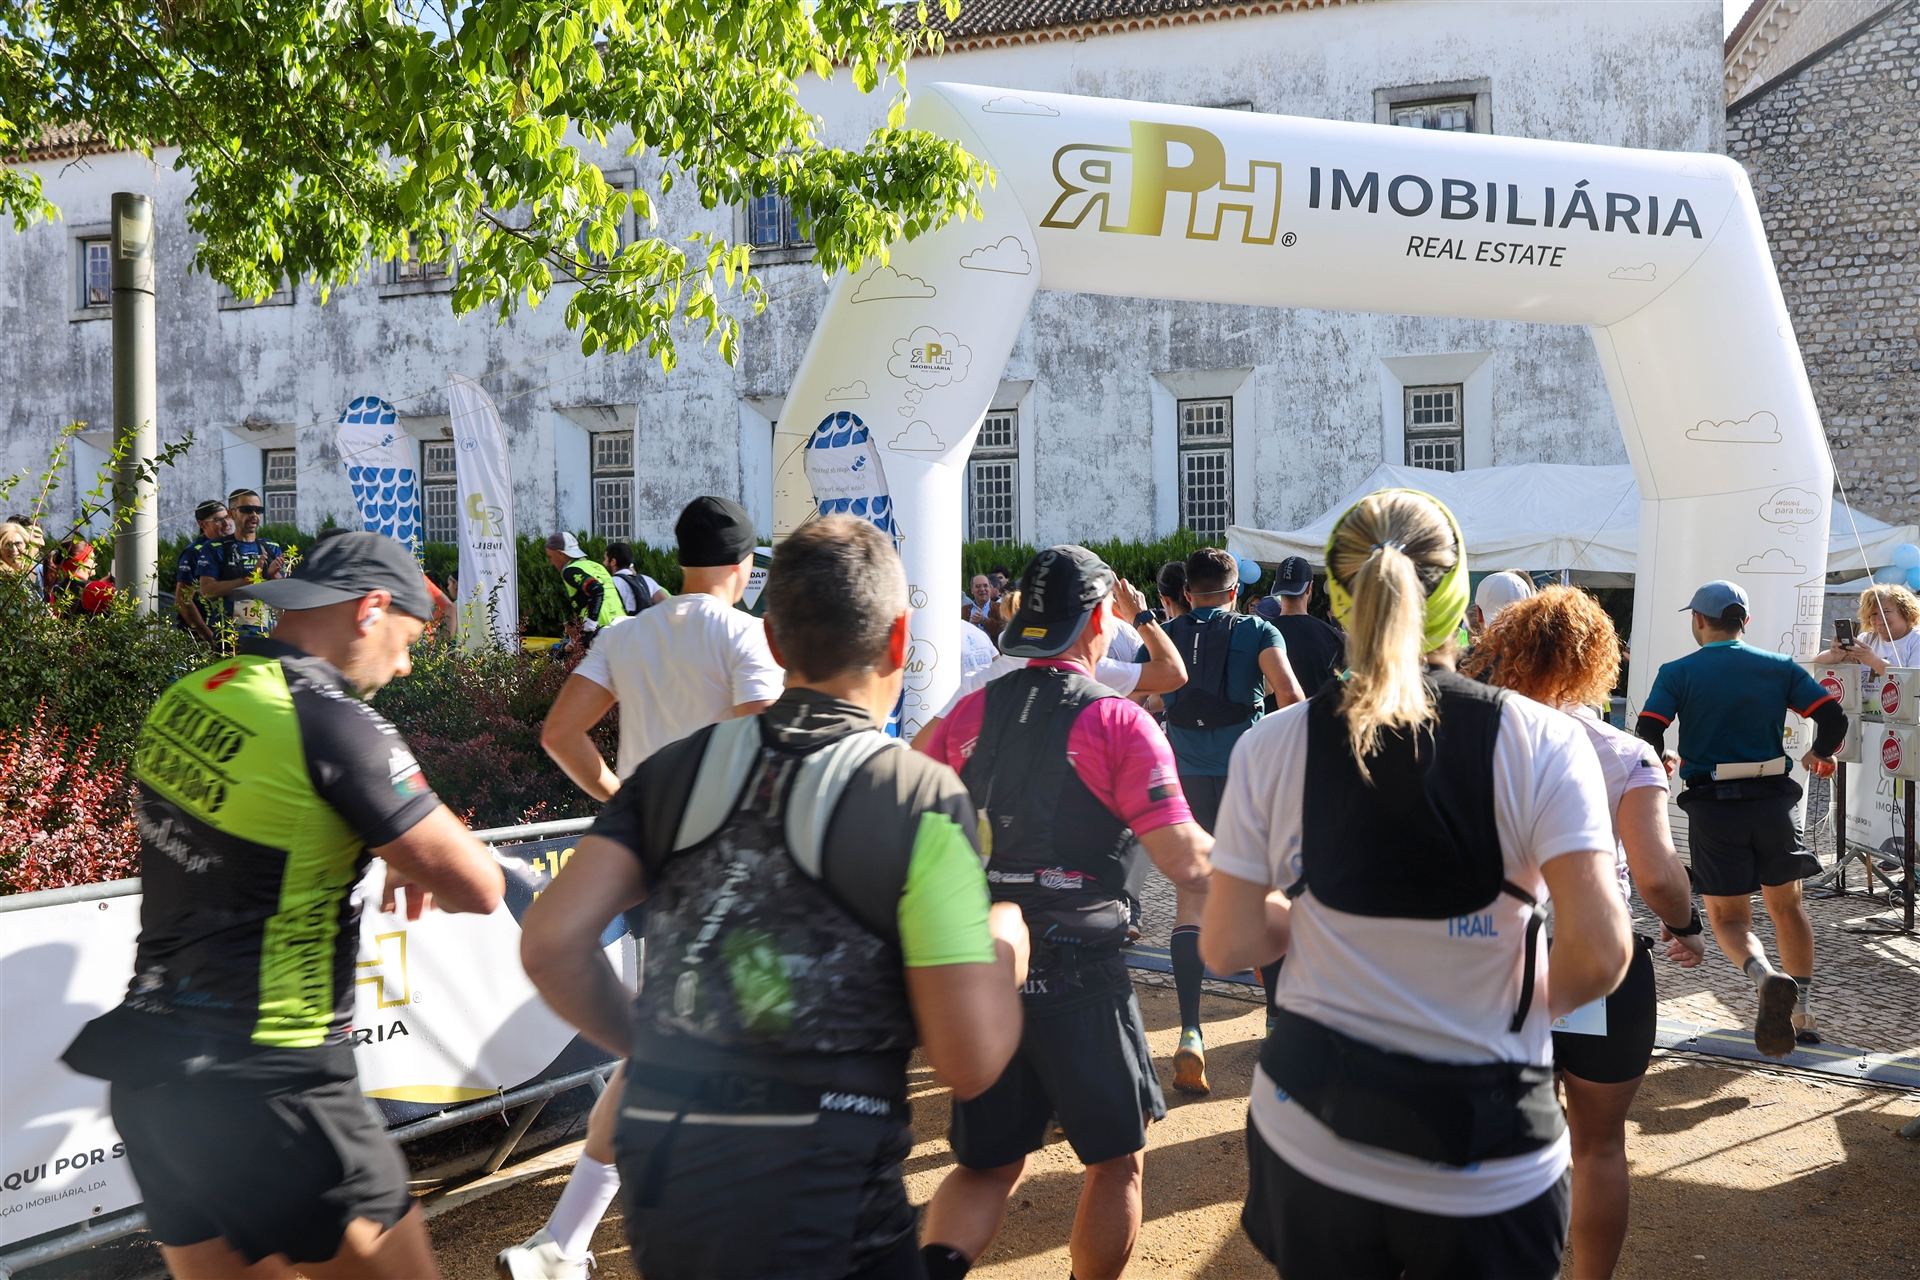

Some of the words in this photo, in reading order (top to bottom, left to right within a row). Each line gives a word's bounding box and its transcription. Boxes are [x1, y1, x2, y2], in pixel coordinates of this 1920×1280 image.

[1308, 166, 1703, 240] IMOBILIÁRIA
[1405, 235, 1468, 261] REAL
[1475, 241, 1567, 268] ESTATE
[1796, 507, 1814, 515] todos
[55, 1148, 105, 1175] POR
[25, 1186, 87, 1209] IMOBILIÁRIA,
[88, 1180, 107, 1191] LDA
